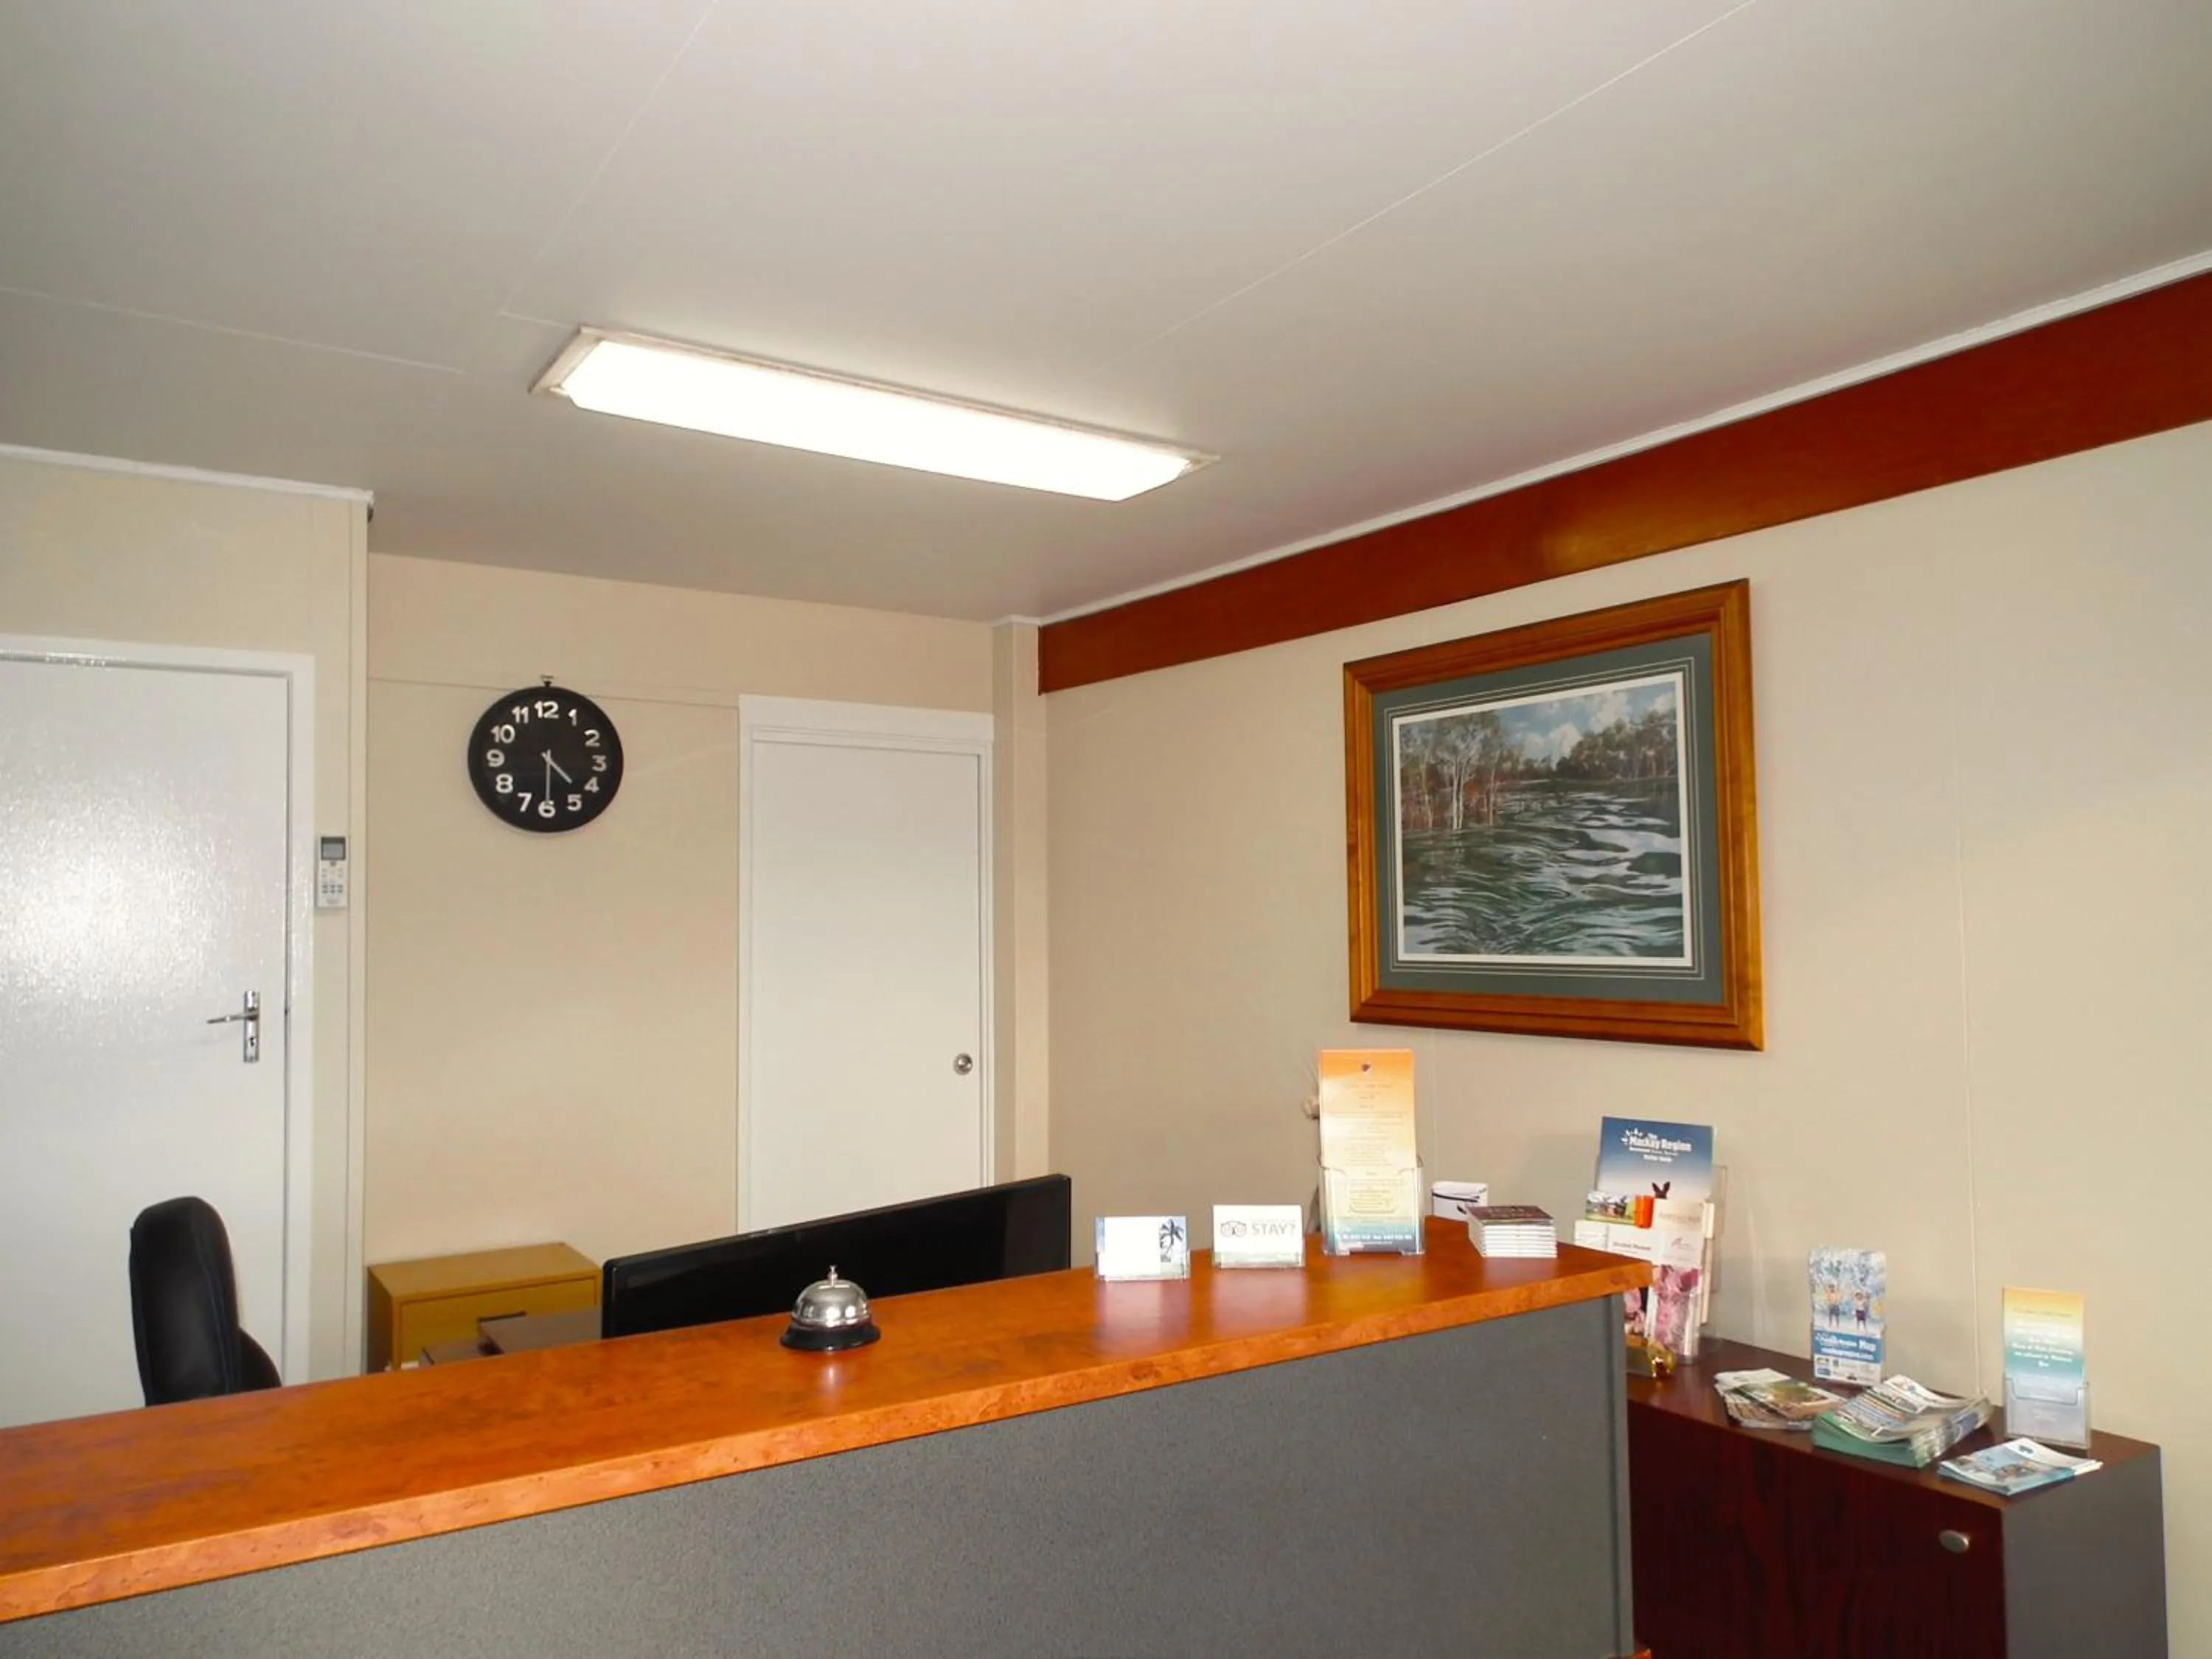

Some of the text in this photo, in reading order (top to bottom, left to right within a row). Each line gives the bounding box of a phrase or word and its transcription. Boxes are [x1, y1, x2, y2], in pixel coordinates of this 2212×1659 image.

[511, 706, 529, 724] 11
[534, 700, 560, 720] 12
[568, 709, 577, 726] 1
[490, 724, 515, 744] 10
[584, 729, 600, 747] 2
[486, 749, 505, 768] 9
[591, 754, 608, 772] 3
[495, 773, 514, 794] 8
[583, 776, 599, 793] 4
[517, 792, 532, 812] 7
[538, 799, 556, 818] 6
[566, 794, 582, 811] 5
[1251, 1222, 1296, 1237] STAY?
